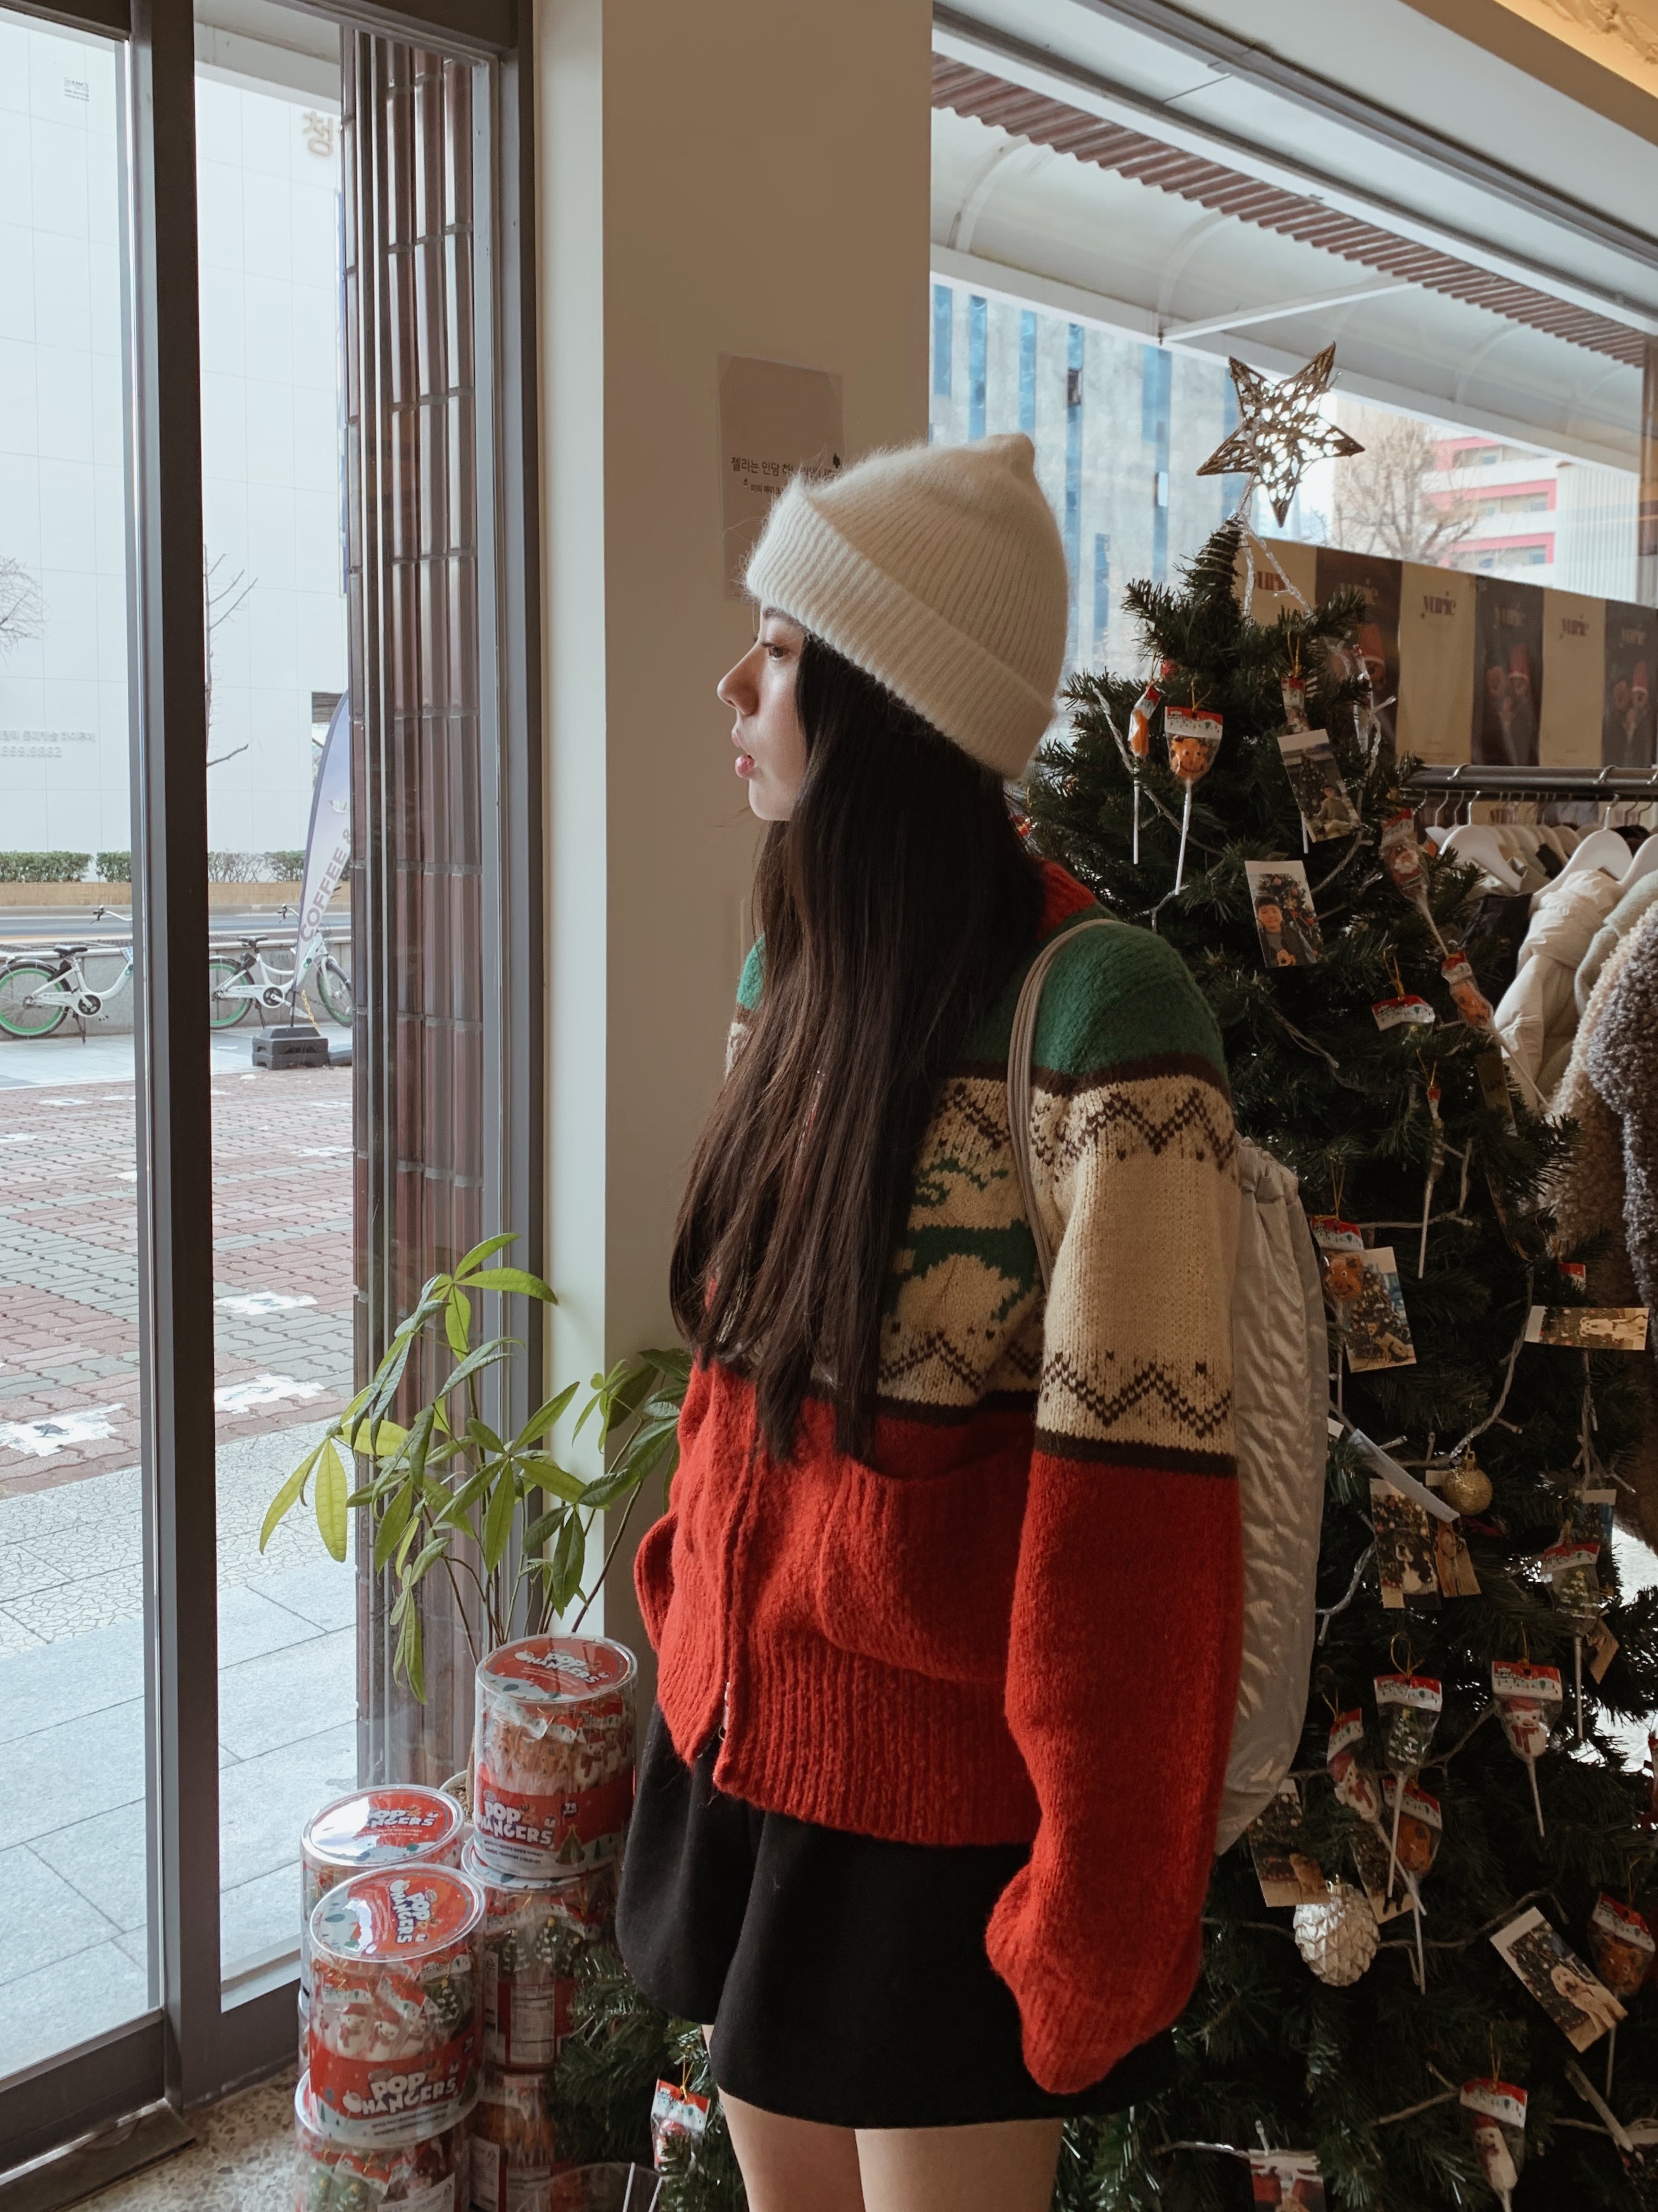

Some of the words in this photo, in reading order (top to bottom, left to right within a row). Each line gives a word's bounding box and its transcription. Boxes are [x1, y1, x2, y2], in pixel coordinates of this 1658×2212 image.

[731, 456, 759, 474] 젤리는
[761, 461, 780, 476] 인당
[299, 846, 348, 942] COFFEE
[543, 1652, 588, 1667] POP
[368, 1809, 406, 1821] OP
[484, 1800, 521, 1824] POP
[480, 1814, 554, 1845] HANGERS
[389, 1891, 414, 1944] HANGERS
[406, 1891, 431, 1921] POP
[360, 2076, 457, 2116] HANGERS
[370, 2071, 426, 2101] POP
